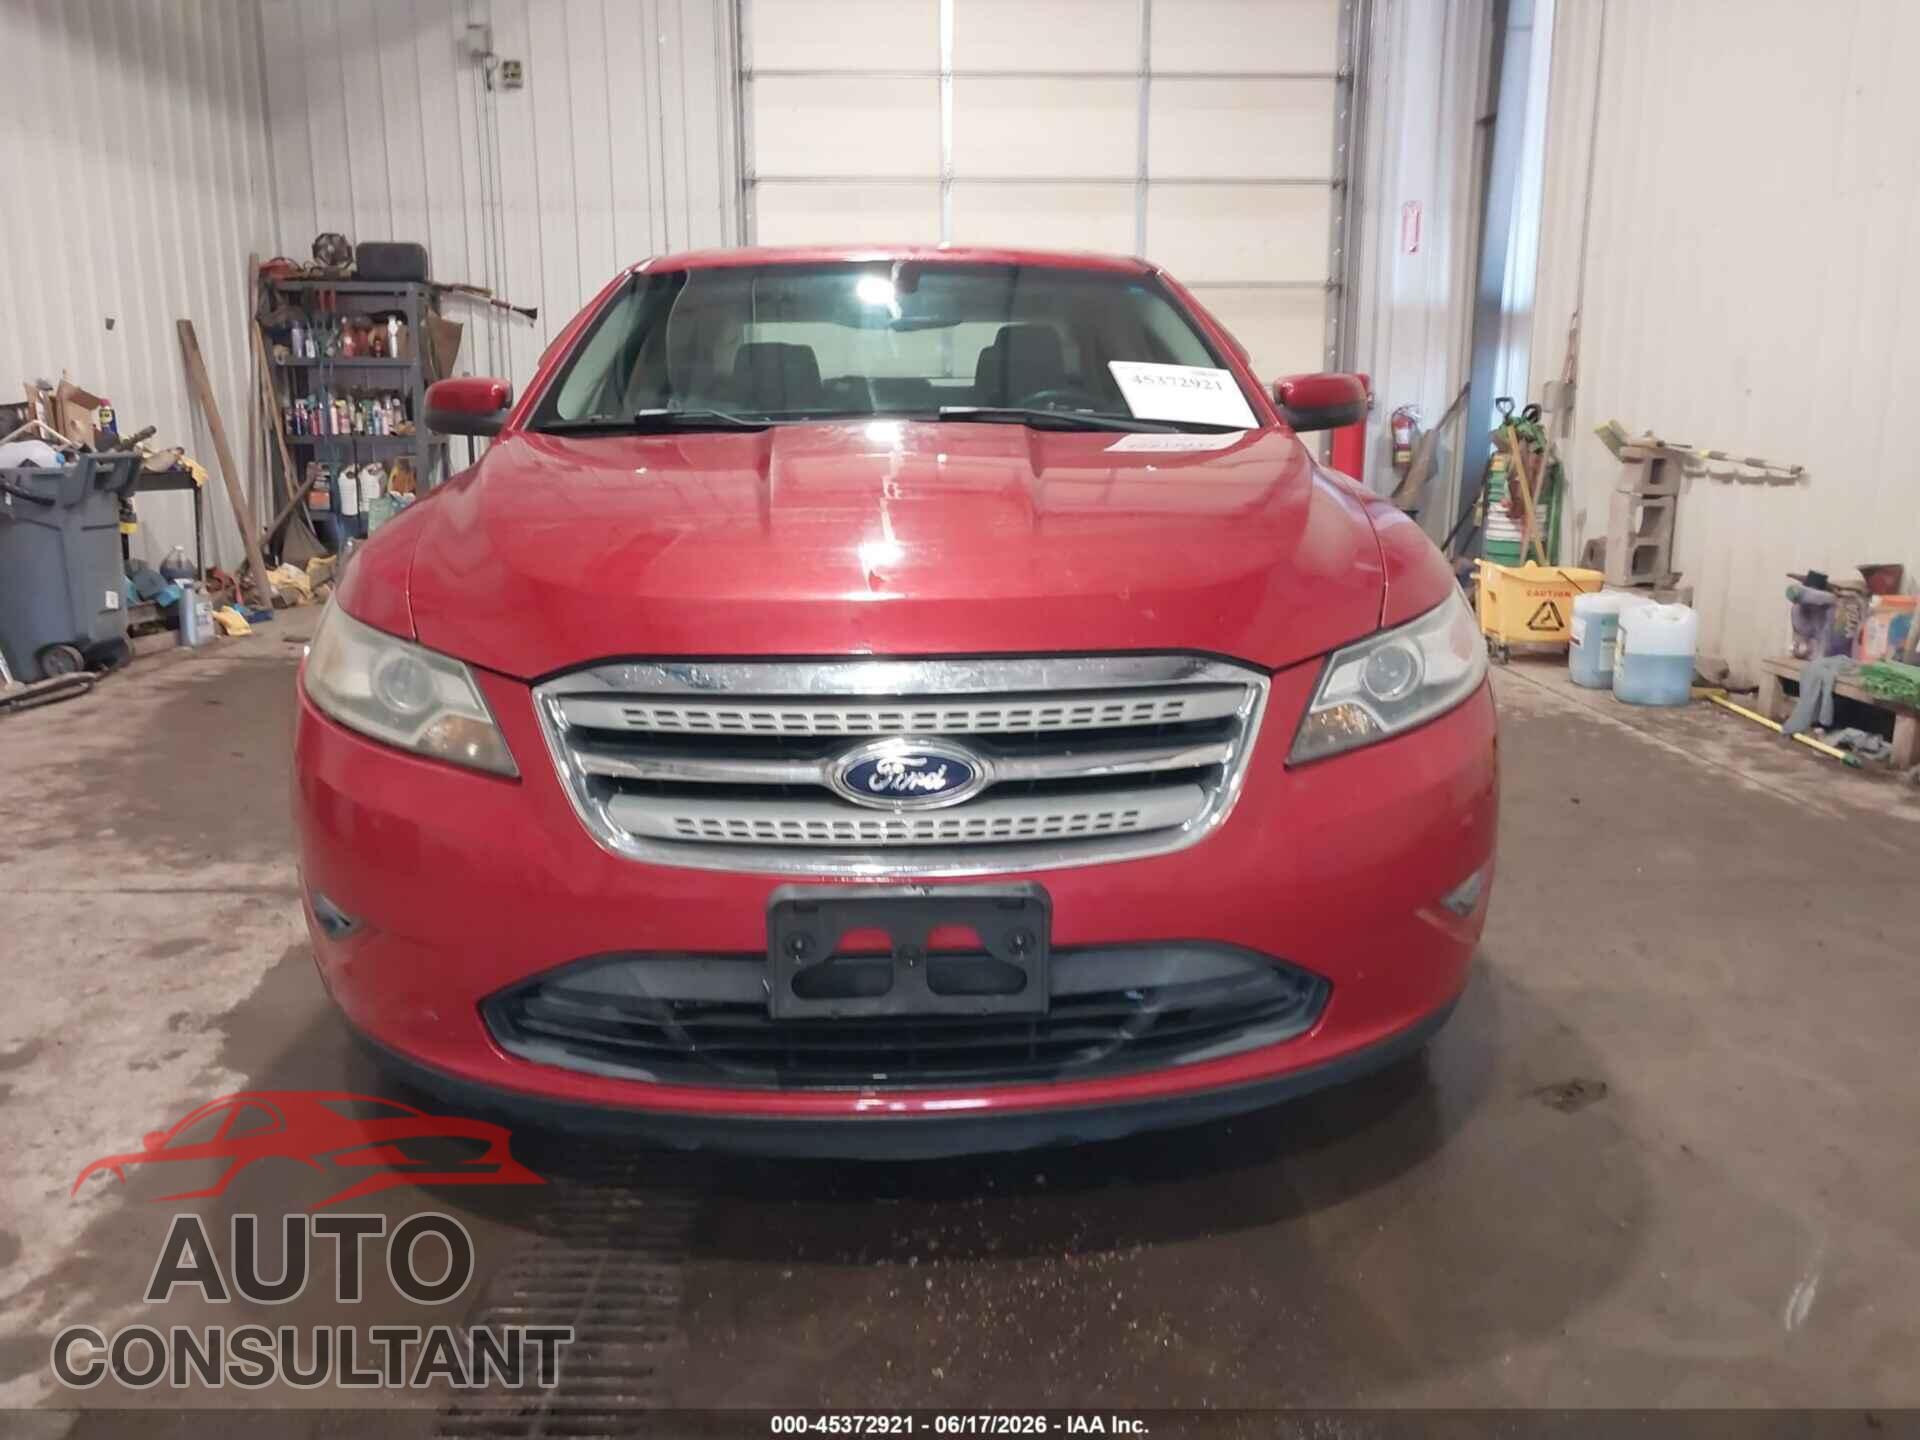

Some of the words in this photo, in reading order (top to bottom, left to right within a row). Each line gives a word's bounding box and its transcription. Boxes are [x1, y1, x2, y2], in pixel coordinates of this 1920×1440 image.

[1132, 374, 1222, 391] 45372921
[1526, 590, 1572, 598] CAUTION
[868, 755, 947, 791] Ford
